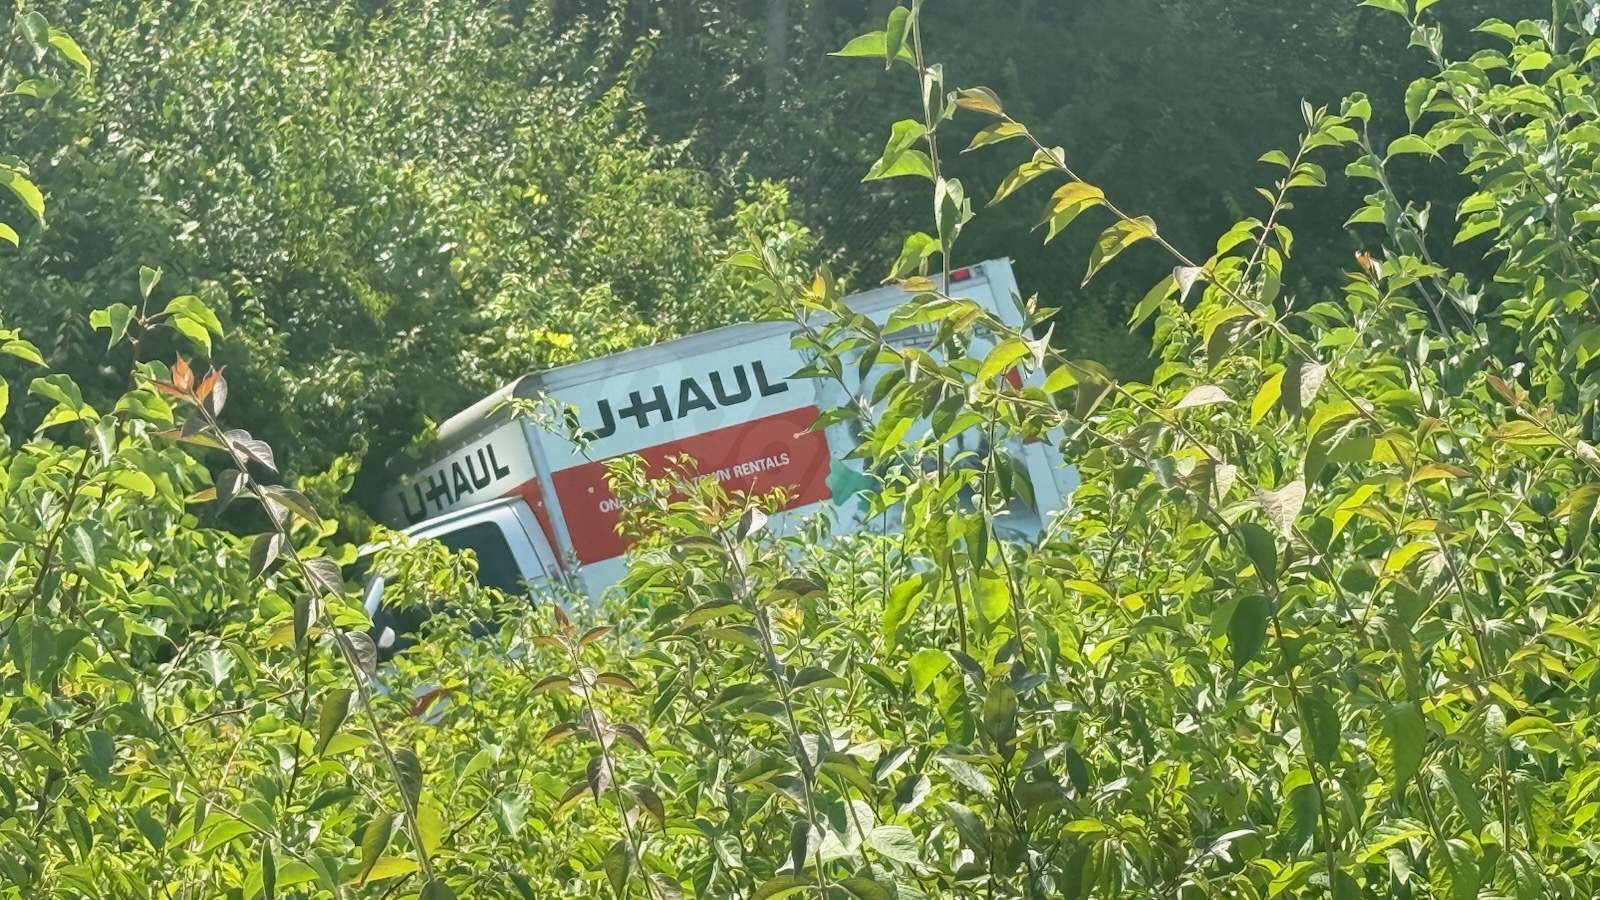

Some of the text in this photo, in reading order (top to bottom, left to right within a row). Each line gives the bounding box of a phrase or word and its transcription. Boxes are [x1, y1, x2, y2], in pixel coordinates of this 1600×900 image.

[563, 360, 789, 442] U-HAUL
[398, 443, 511, 525] U-HAUL
[733, 453, 790, 478] RENTALS
